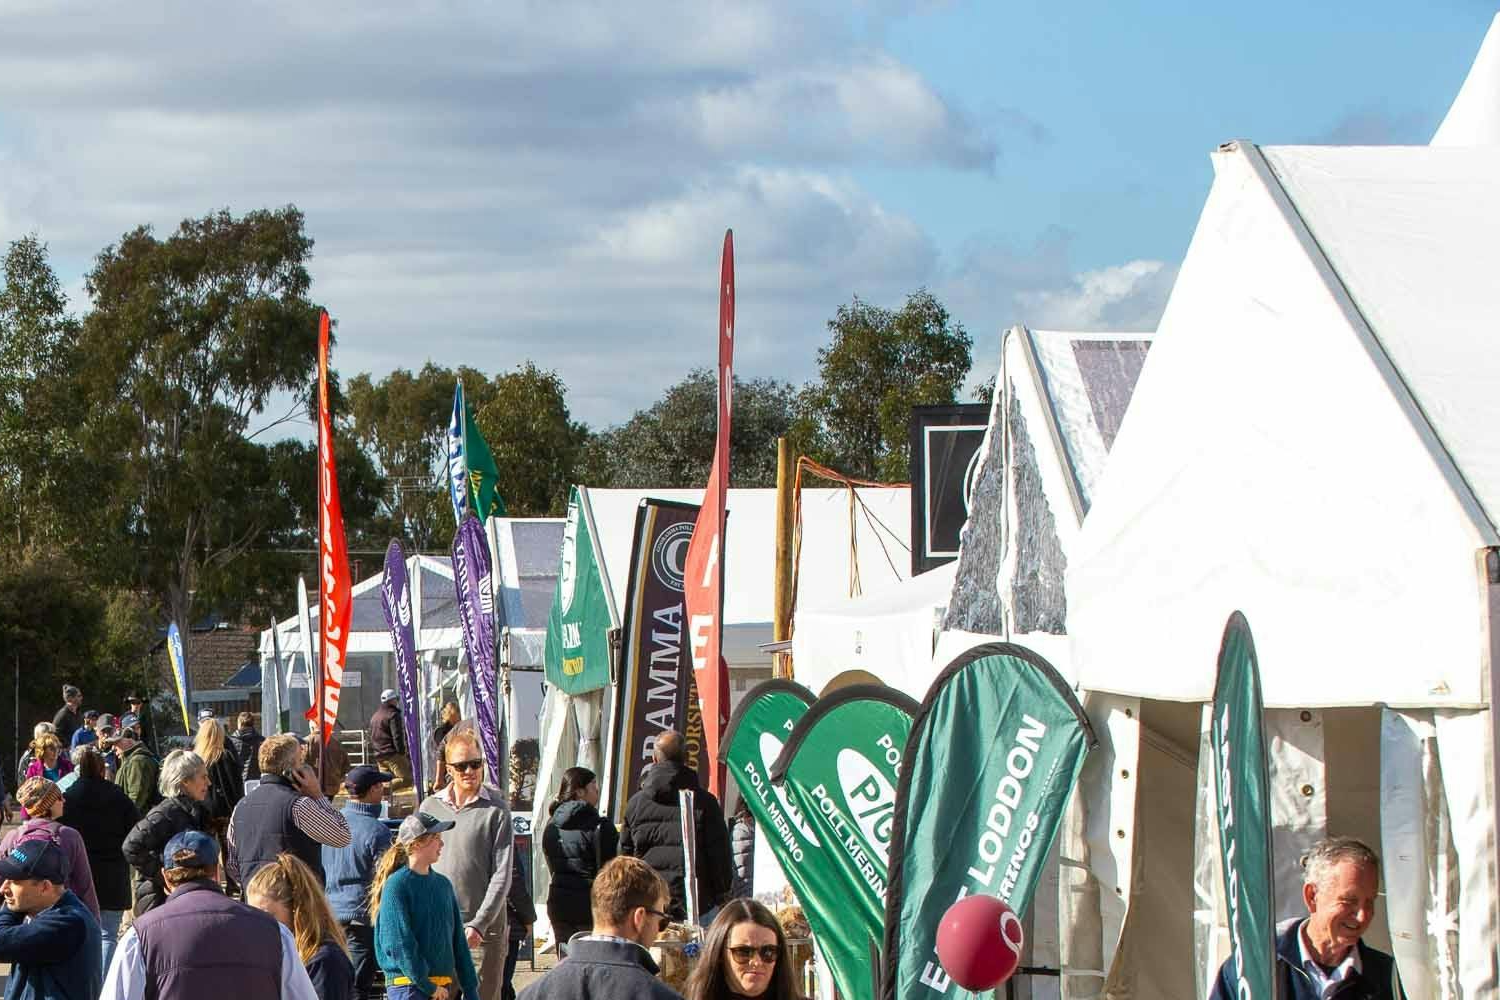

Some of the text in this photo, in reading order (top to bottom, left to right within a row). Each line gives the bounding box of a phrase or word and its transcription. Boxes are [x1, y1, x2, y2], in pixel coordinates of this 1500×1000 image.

[744, 761, 769, 805] POLL
[766, 801, 804, 863] MERINO
[811, 783, 888, 909] POLL MERIN
[967, 713, 1047, 887] LODDON
